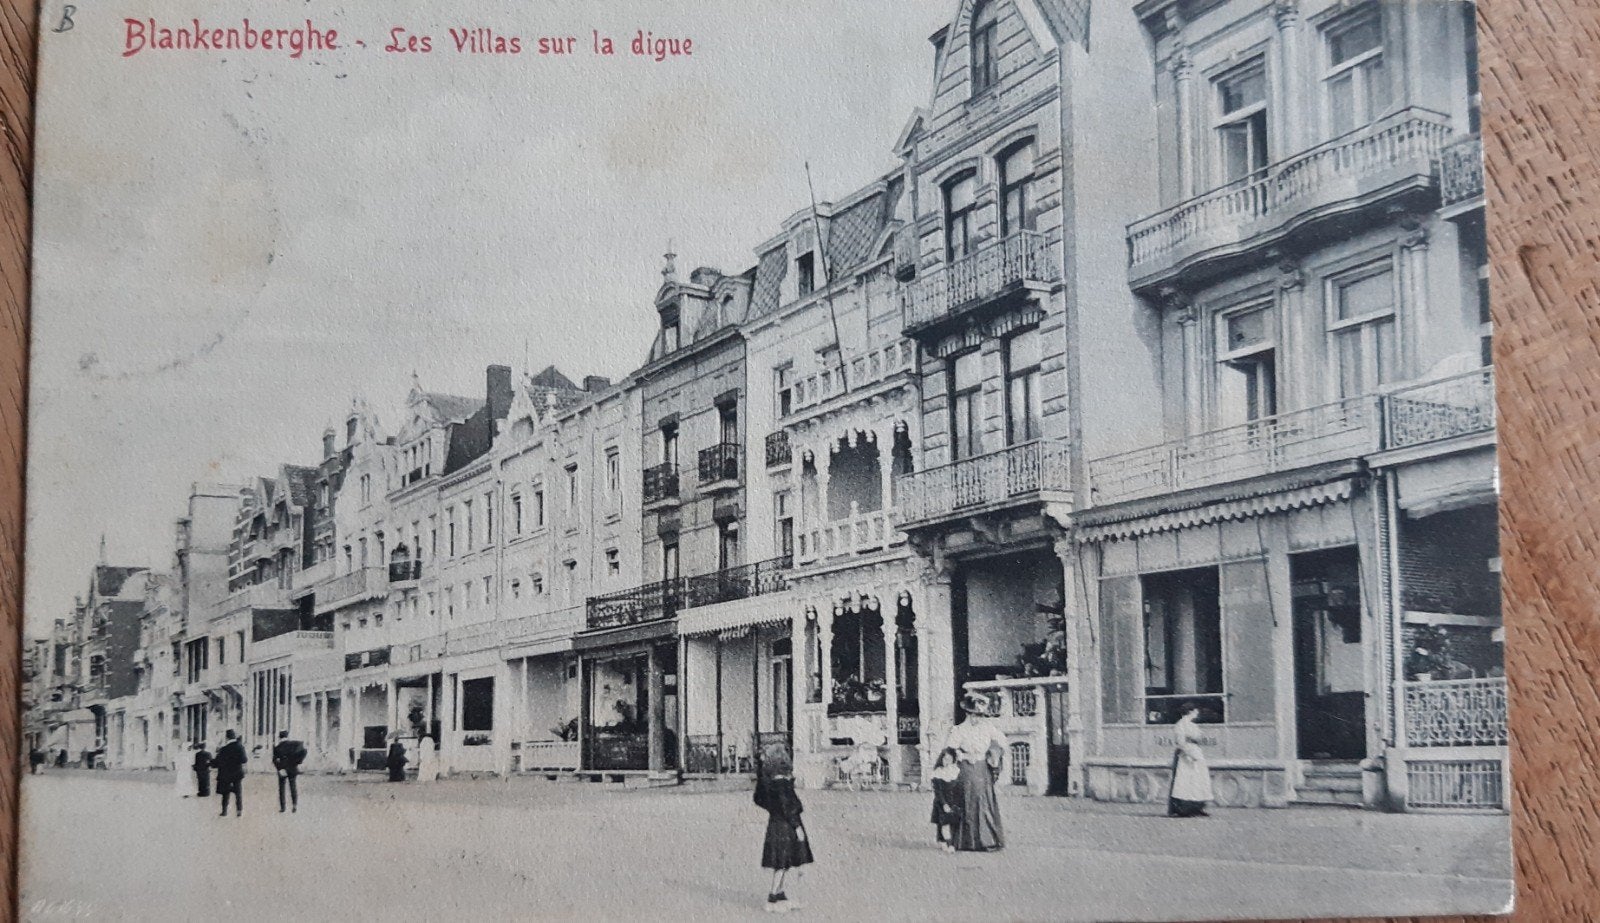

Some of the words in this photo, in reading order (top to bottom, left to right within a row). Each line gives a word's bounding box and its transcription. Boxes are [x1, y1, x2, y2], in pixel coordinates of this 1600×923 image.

[122, 18, 338, 58] Blankenberghe
[385, 27, 432, 53] Les
[449, 28, 521, 54] Villas
[538, 37, 576, 55] sur
[592, 29, 615, 56] la
[631, 30, 693, 61] digue
